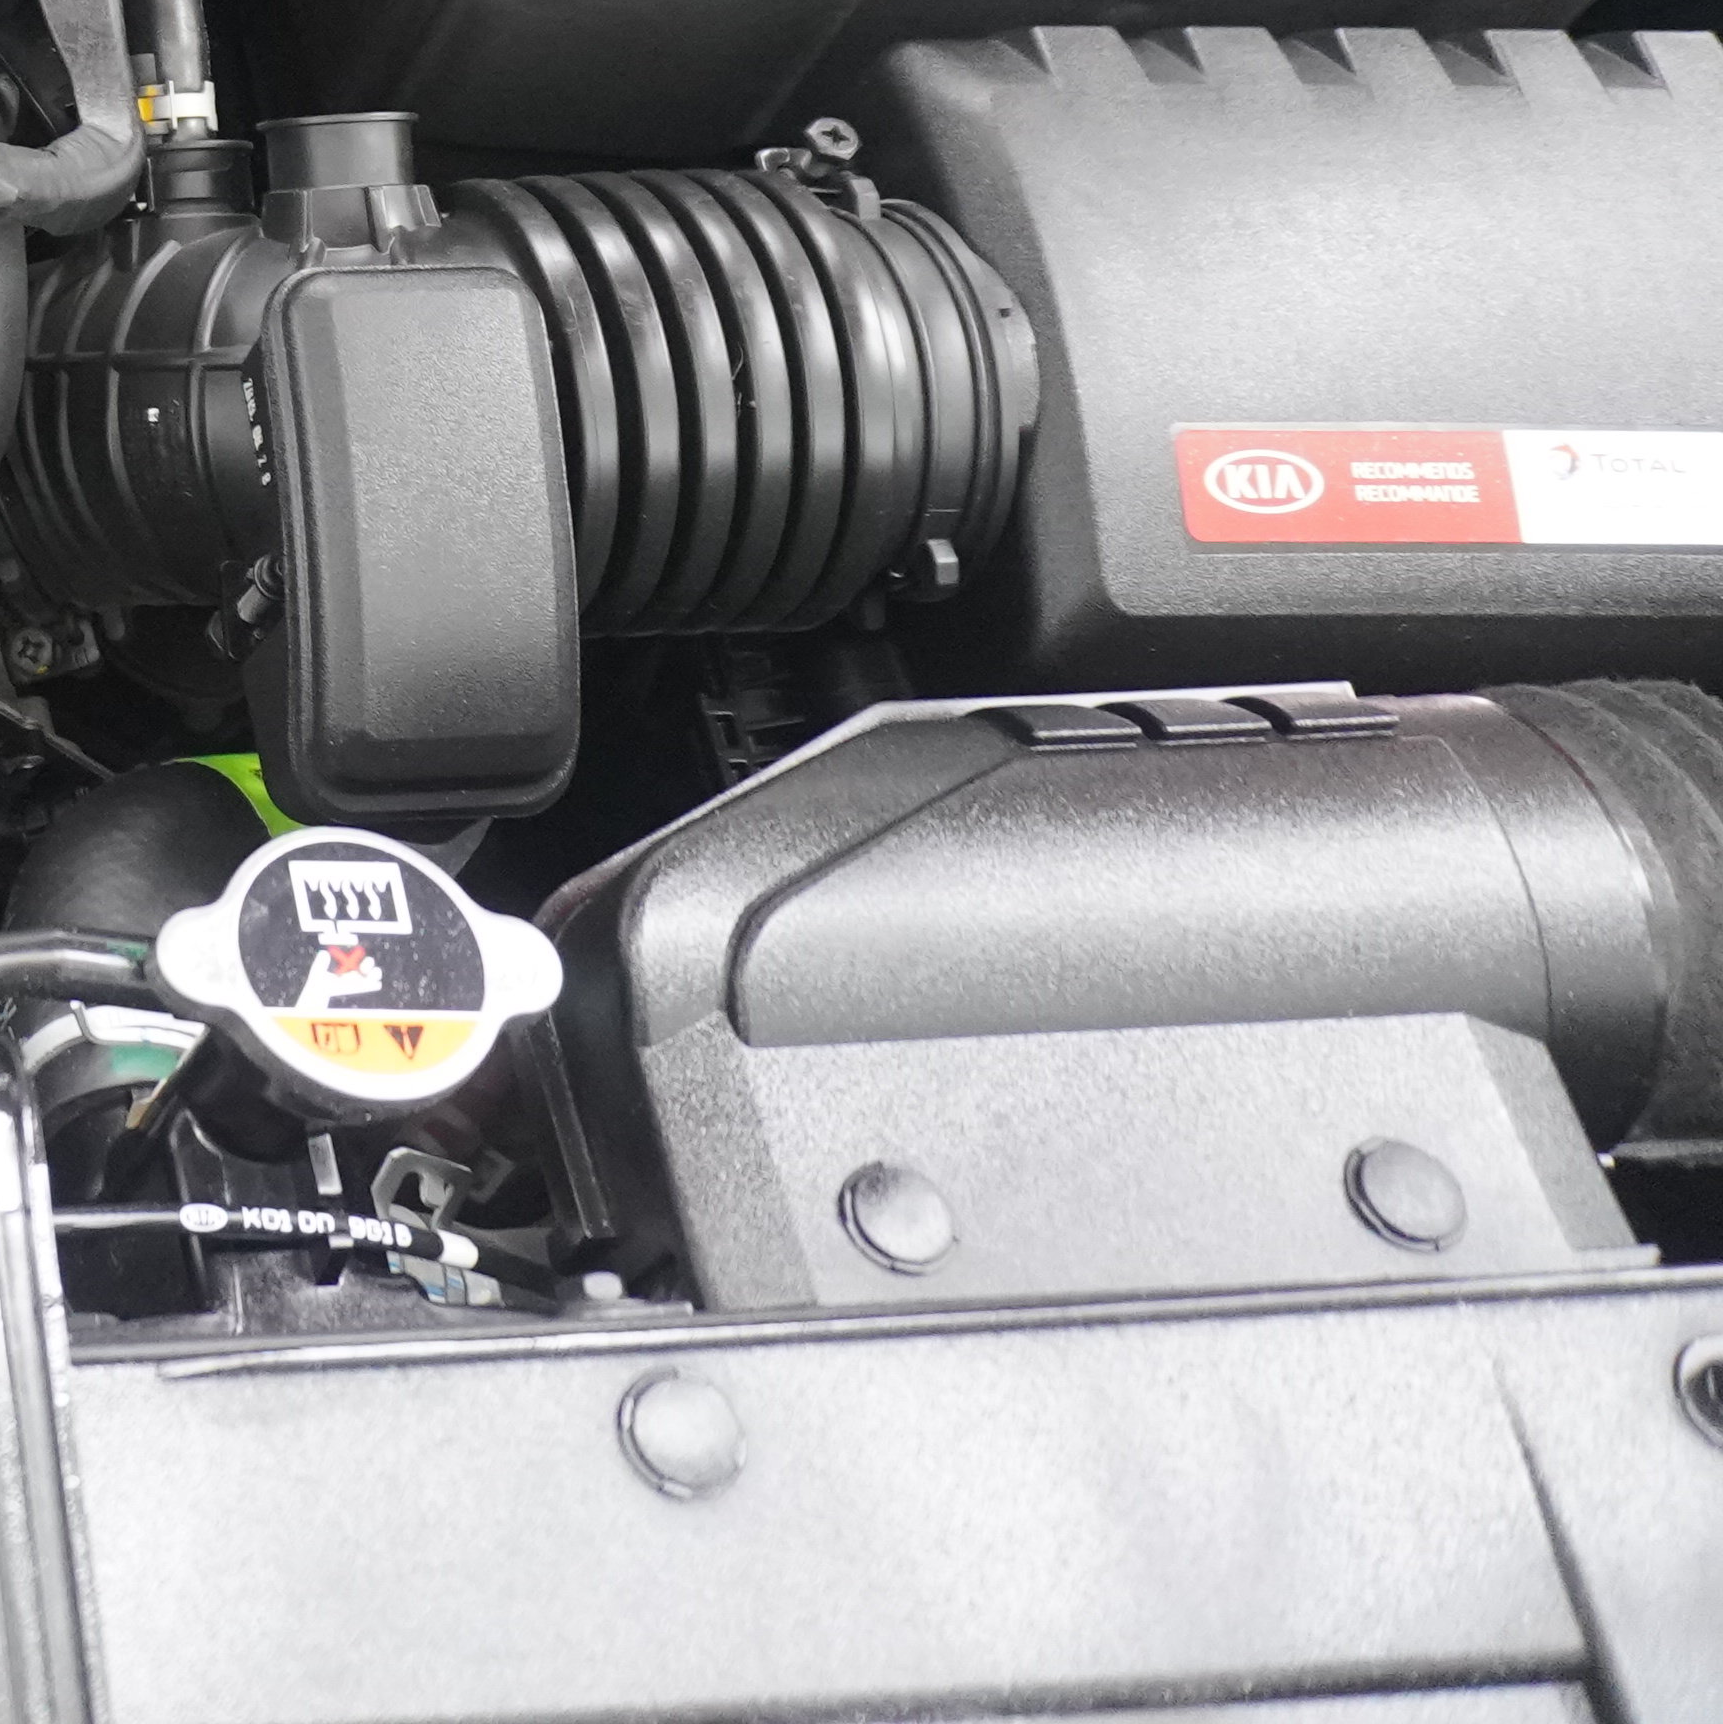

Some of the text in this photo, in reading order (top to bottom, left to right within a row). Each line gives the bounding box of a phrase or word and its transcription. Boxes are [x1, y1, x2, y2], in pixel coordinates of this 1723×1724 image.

[1222, 451, 1687, 499] KIA RECOMMENDS TOTAL
[1355, 484, 1481, 504] RECOMMANDE
